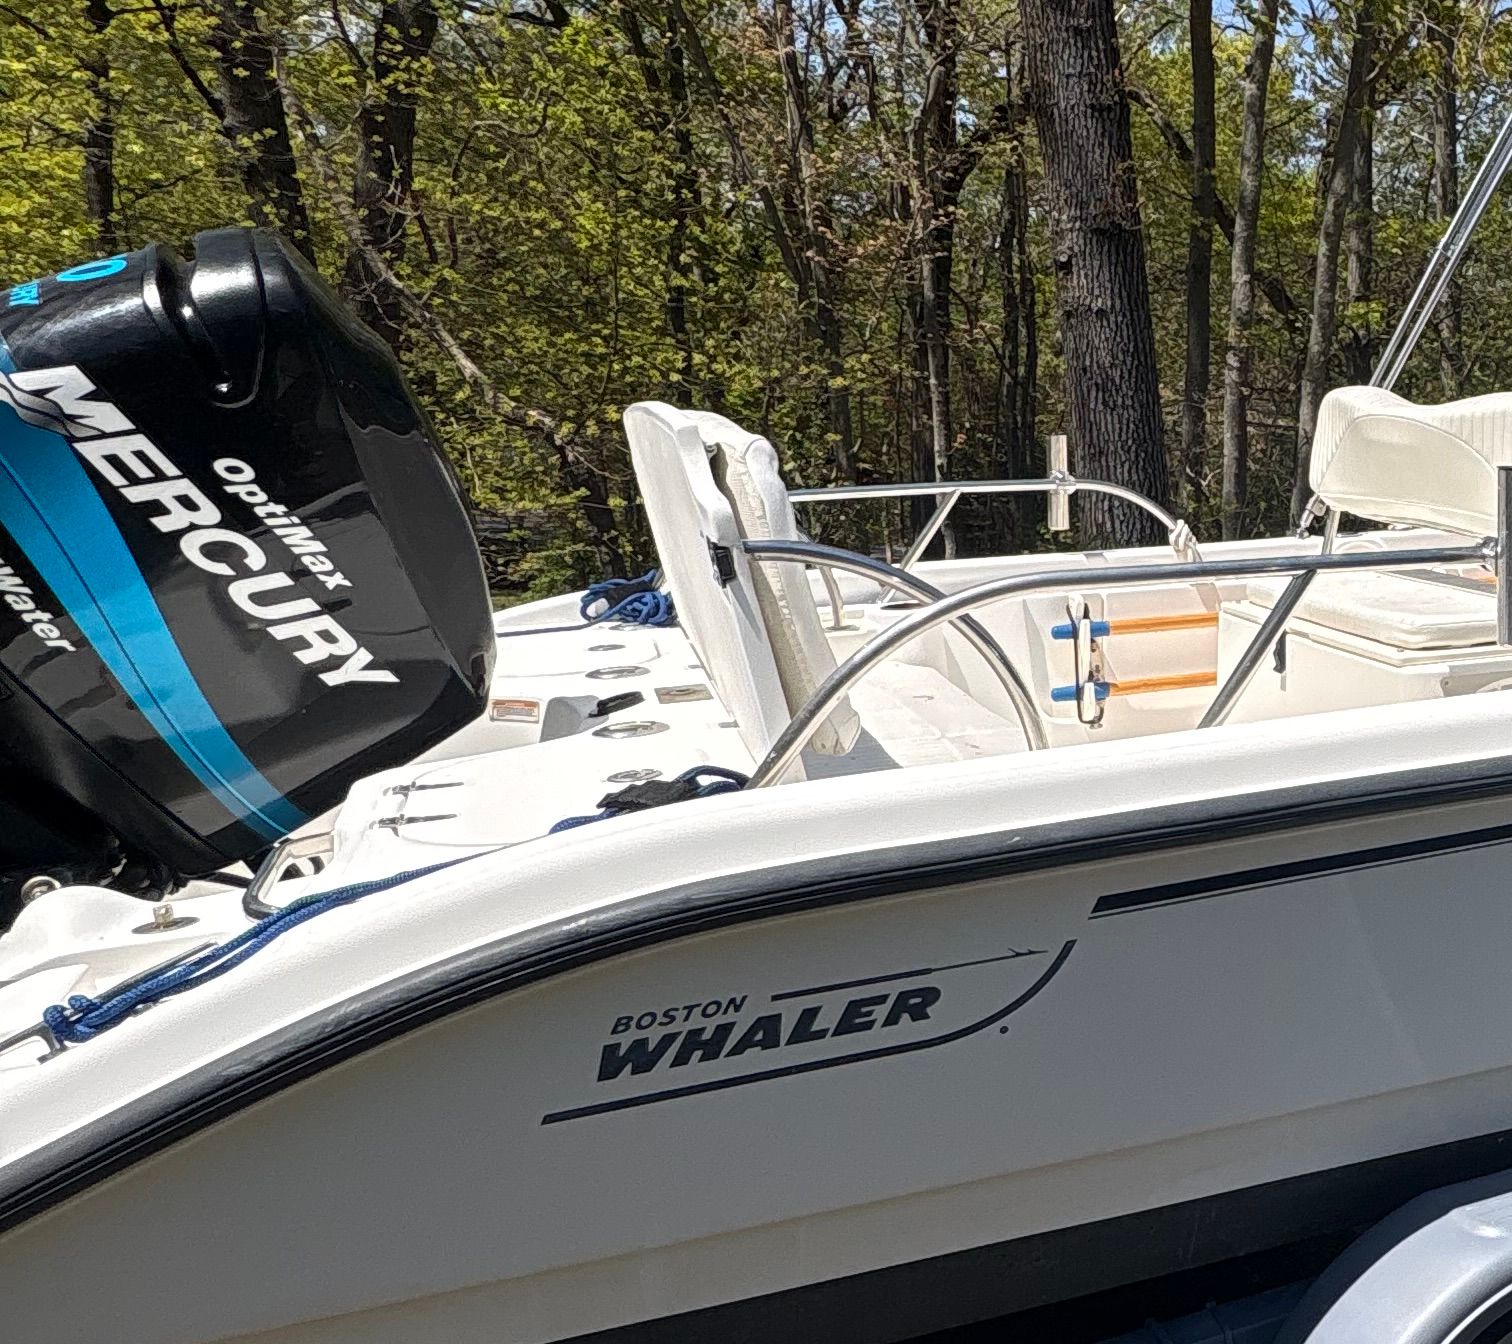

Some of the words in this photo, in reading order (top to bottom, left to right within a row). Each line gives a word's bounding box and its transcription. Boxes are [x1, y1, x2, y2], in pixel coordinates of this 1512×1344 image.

[9, 364, 400, 687] MERCURY
[213, 457, 353, 591] OptiMax
[0, 558, 77, 653] Water
[597, 986, 942, 1083] WHALER
[610, 995, 749, 1036] BOSTON
